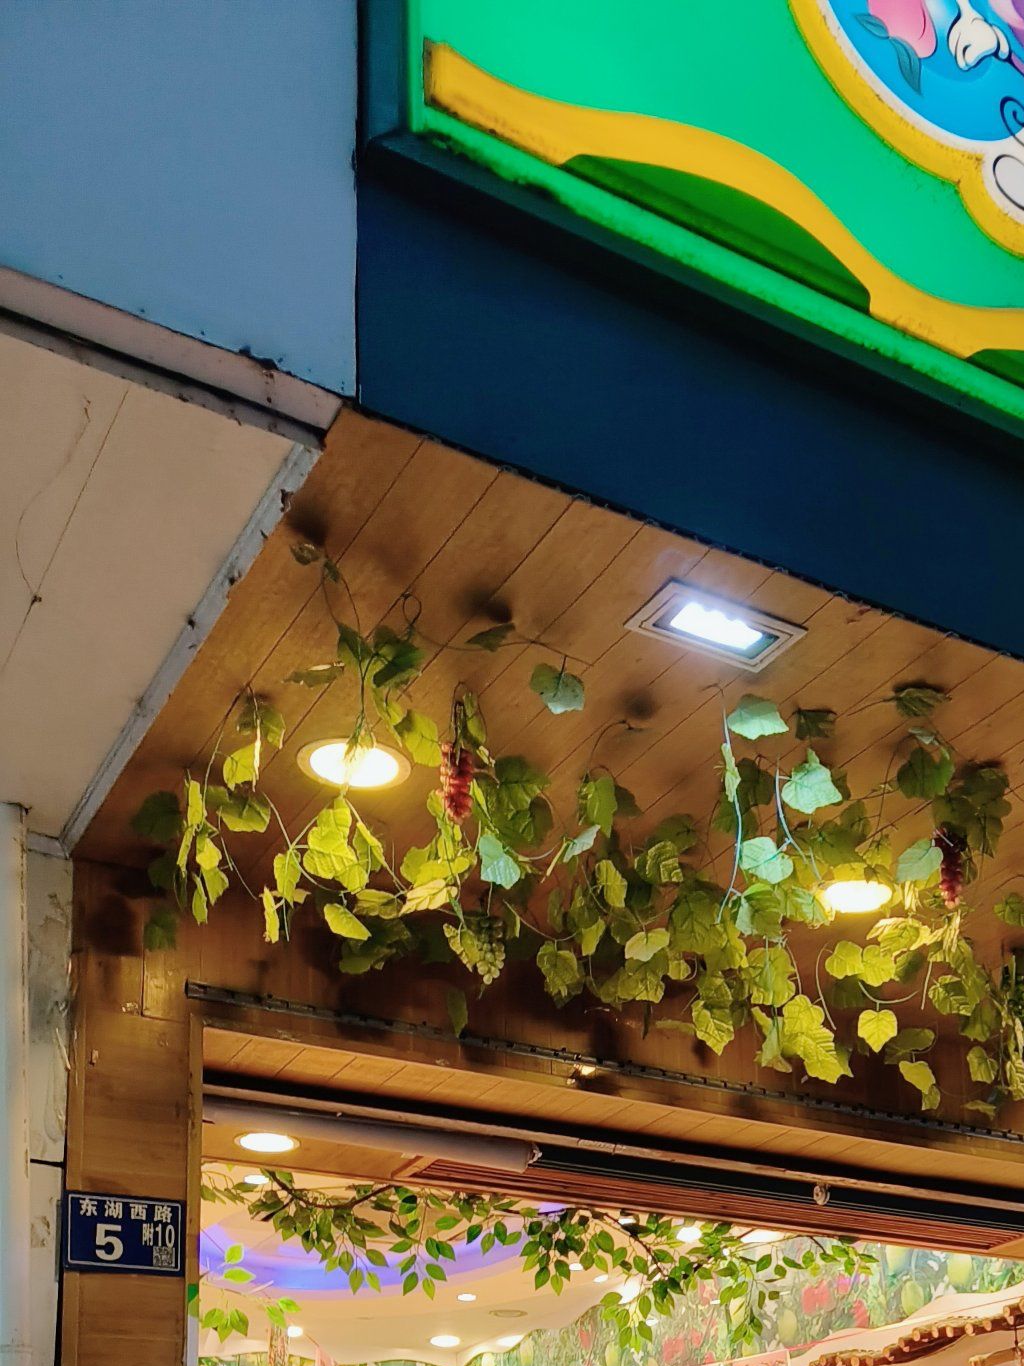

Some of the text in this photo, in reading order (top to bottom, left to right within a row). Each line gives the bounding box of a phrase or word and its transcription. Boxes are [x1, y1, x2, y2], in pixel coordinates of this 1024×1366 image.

[79, 1198, 173, 1223] 东湖西路
[95, 1222, 175, 1261] 5 附10
